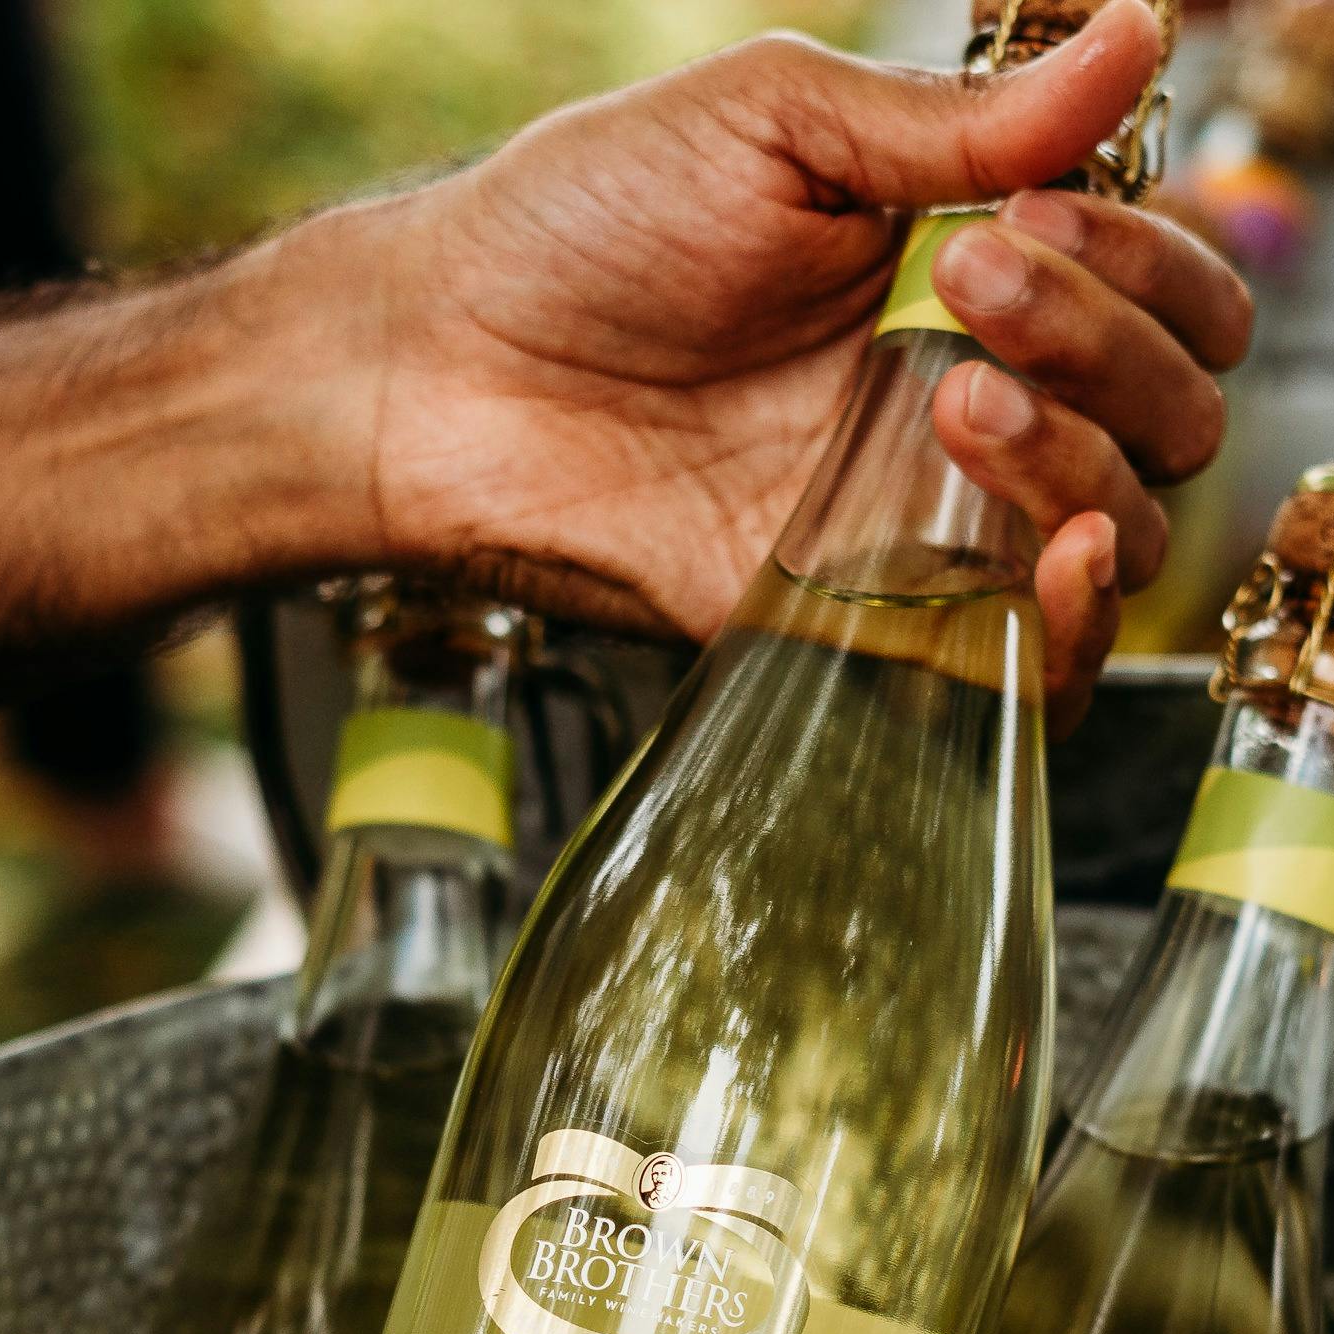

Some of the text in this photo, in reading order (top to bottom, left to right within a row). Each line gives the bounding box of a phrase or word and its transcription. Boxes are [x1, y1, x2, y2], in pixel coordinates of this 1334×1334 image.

[561, 1206, 737, 1283] BROWN
[527, 1239, 749, 1328] BROTHERS
[538, 1286, 598, 1311] FAMILY
